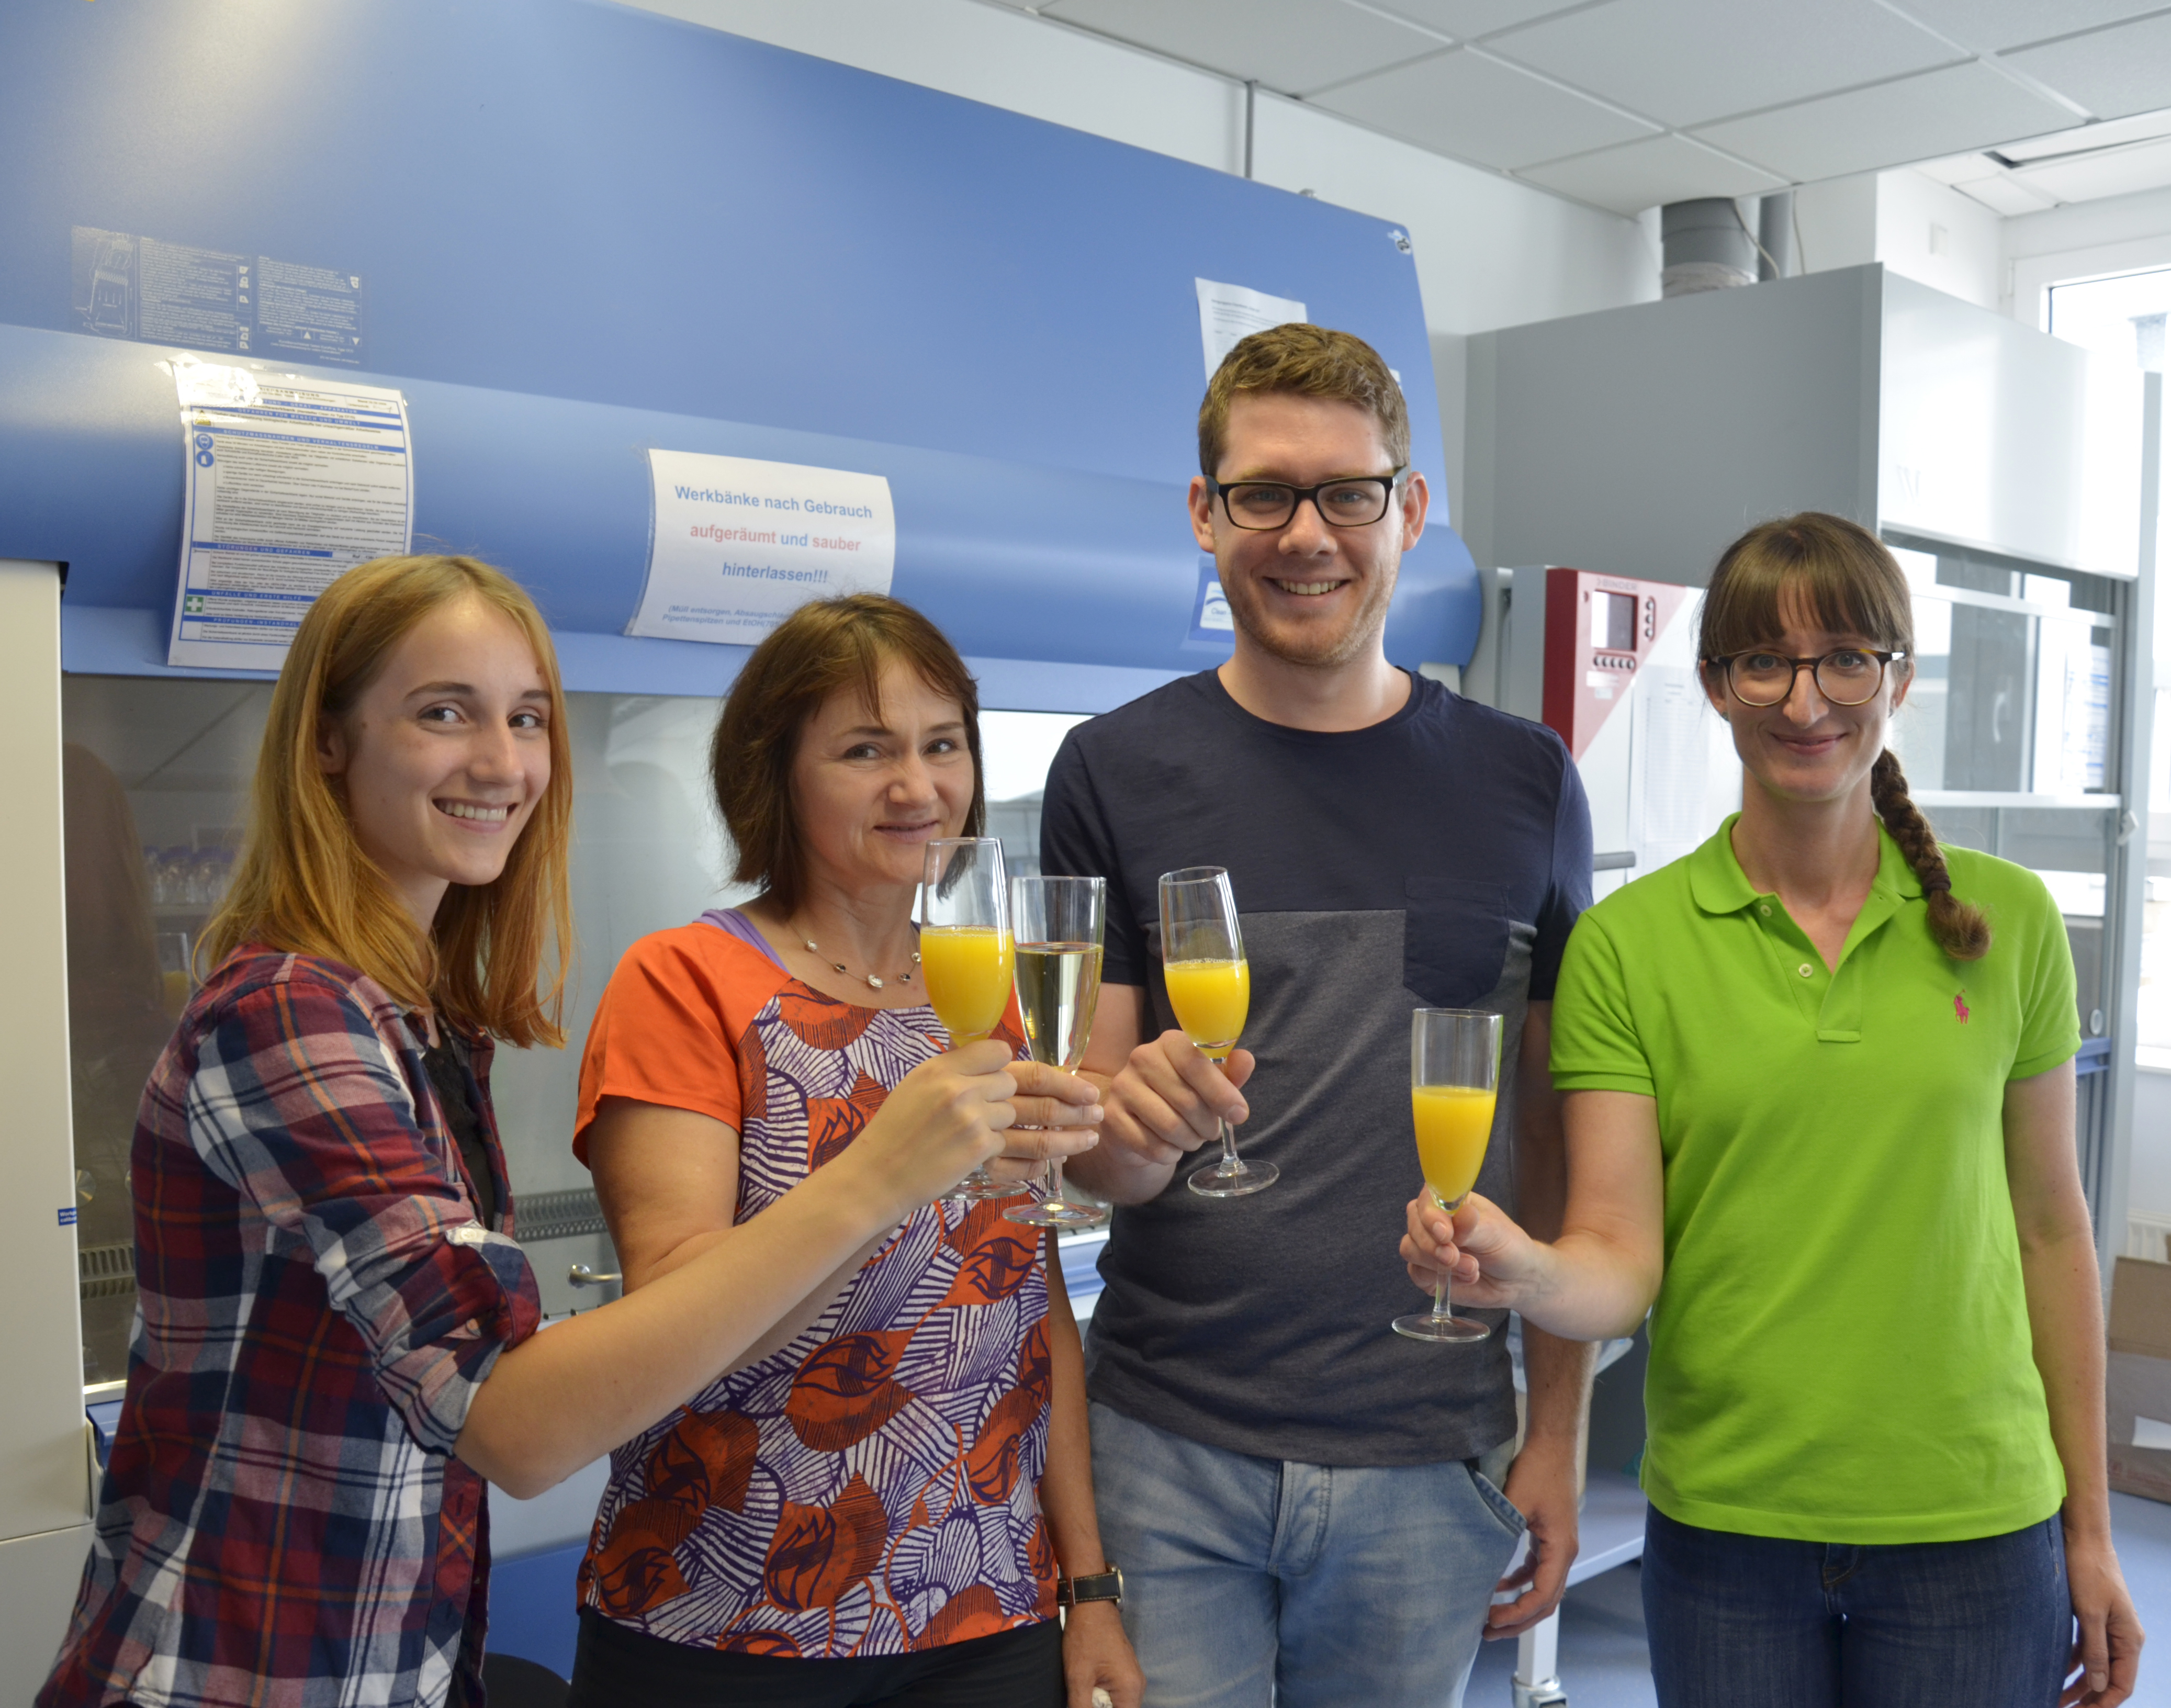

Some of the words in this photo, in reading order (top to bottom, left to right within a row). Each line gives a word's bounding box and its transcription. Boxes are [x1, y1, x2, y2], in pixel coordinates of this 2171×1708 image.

[223, 430, 295, 441] SCHUTZMASSNAHMEN
[314, 439, 379, 450] VERHALTENSREGELN
[674, 486, 760, 507] Werkbänke
[764, 497, 800, 511] nach
[804, 499, 873, 519] Gebrauch
[690, 525, 777, 544] aufgeräumt
[781, 533, 808, 546] und
[812, 536, 861, 551] sauber
[722, 562, 828, 583] hinterlassen!!!
[1603, 578, 1637, 591] BINDER
[662, 614, 724, 625] Pipettenspitzen
[690, 607, 732, 616] entsorgen,
[213, 617, 300, 627] PRÜFUNGEN-INSTANDHAL
